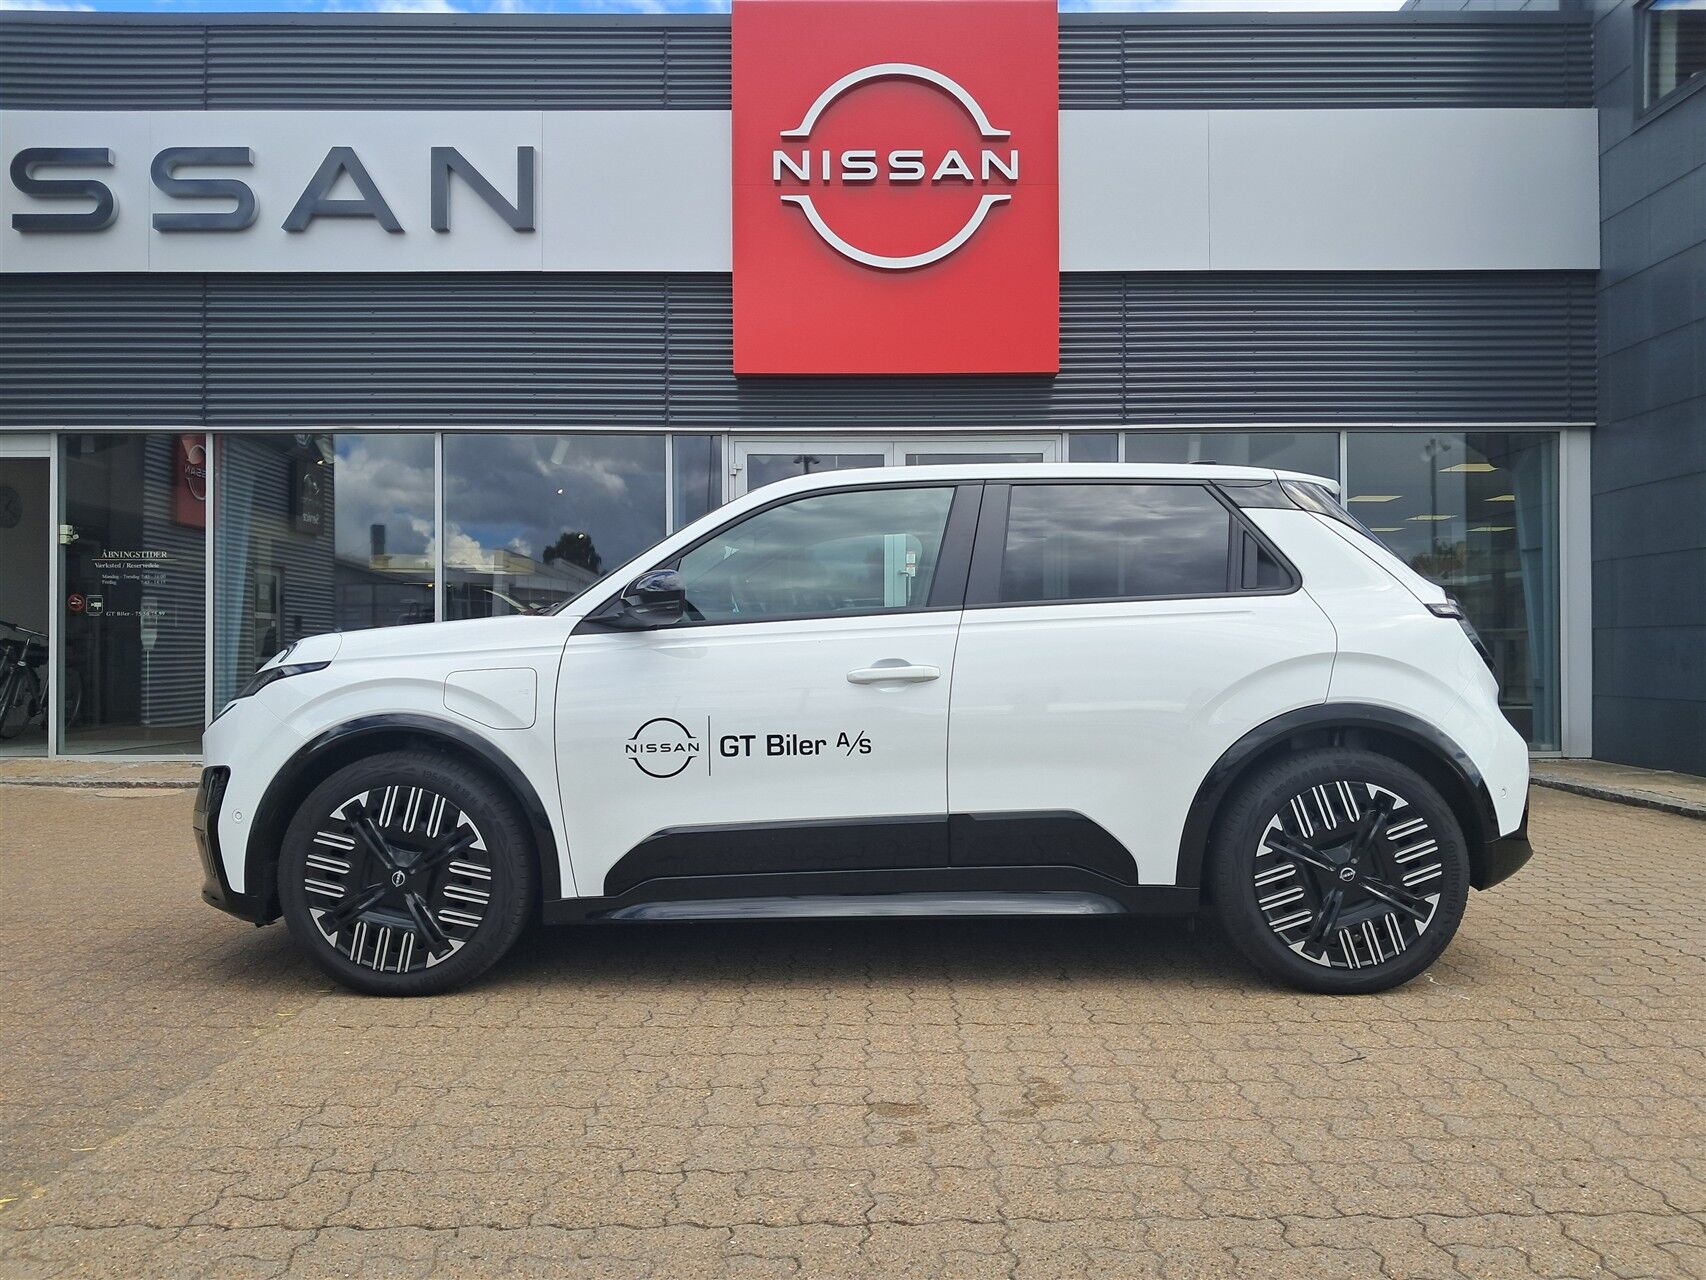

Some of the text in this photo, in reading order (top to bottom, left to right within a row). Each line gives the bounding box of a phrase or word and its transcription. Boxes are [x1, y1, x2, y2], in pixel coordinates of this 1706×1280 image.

[773, 150, 1019, 181] NISSAN
[10, 146, 537, 234] SSAN
[101, 549, 167, 558] ÅBNINGSTIDER
[625, 742, 700, 754] NISSAN
[719, 734, 756, 757] GT
[766, 733, 827, 757] Biler
